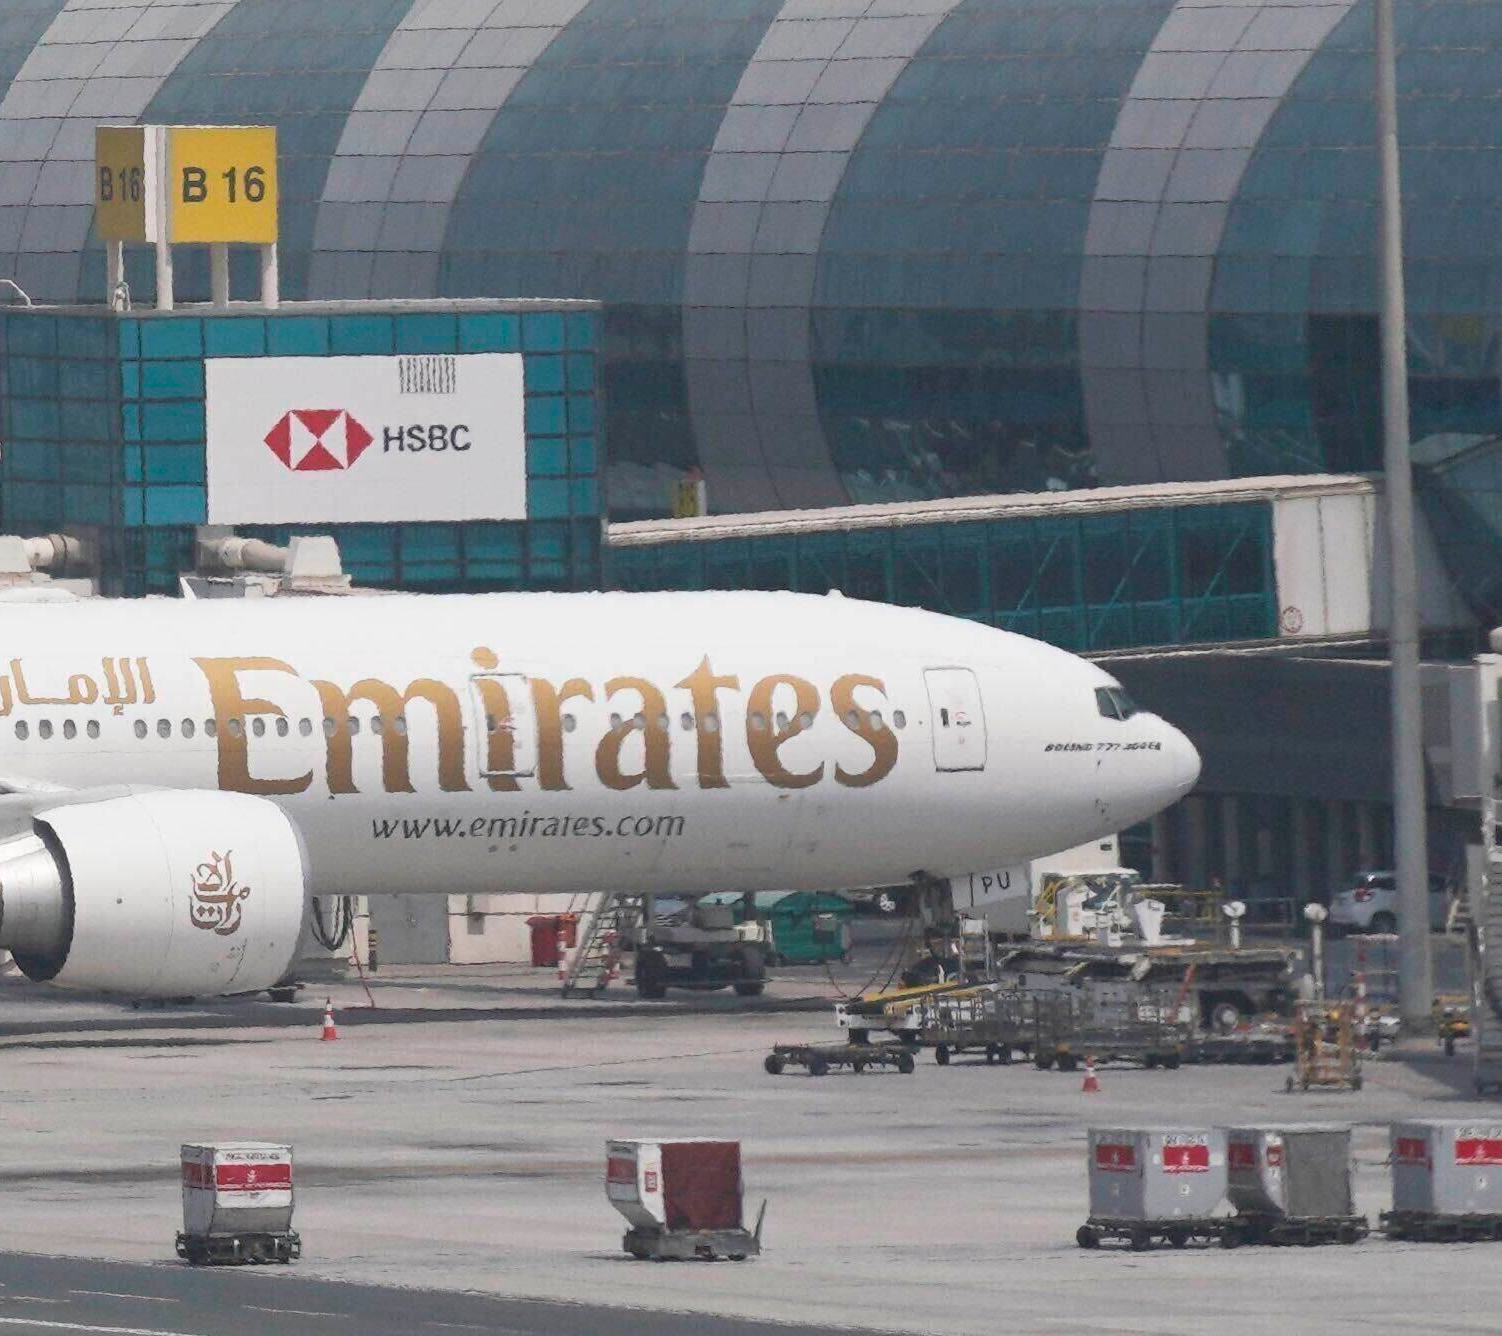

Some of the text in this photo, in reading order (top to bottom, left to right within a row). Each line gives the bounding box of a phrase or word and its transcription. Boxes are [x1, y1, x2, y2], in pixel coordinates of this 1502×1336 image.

[182, 165, 265, 203] B 16
[383, 424, 472, 453] HSBC
[191, 646, 900, 795] Emirates
[372, 810, 686, 839] www.emirates.com
[981, 871, 1011, 894] PU
